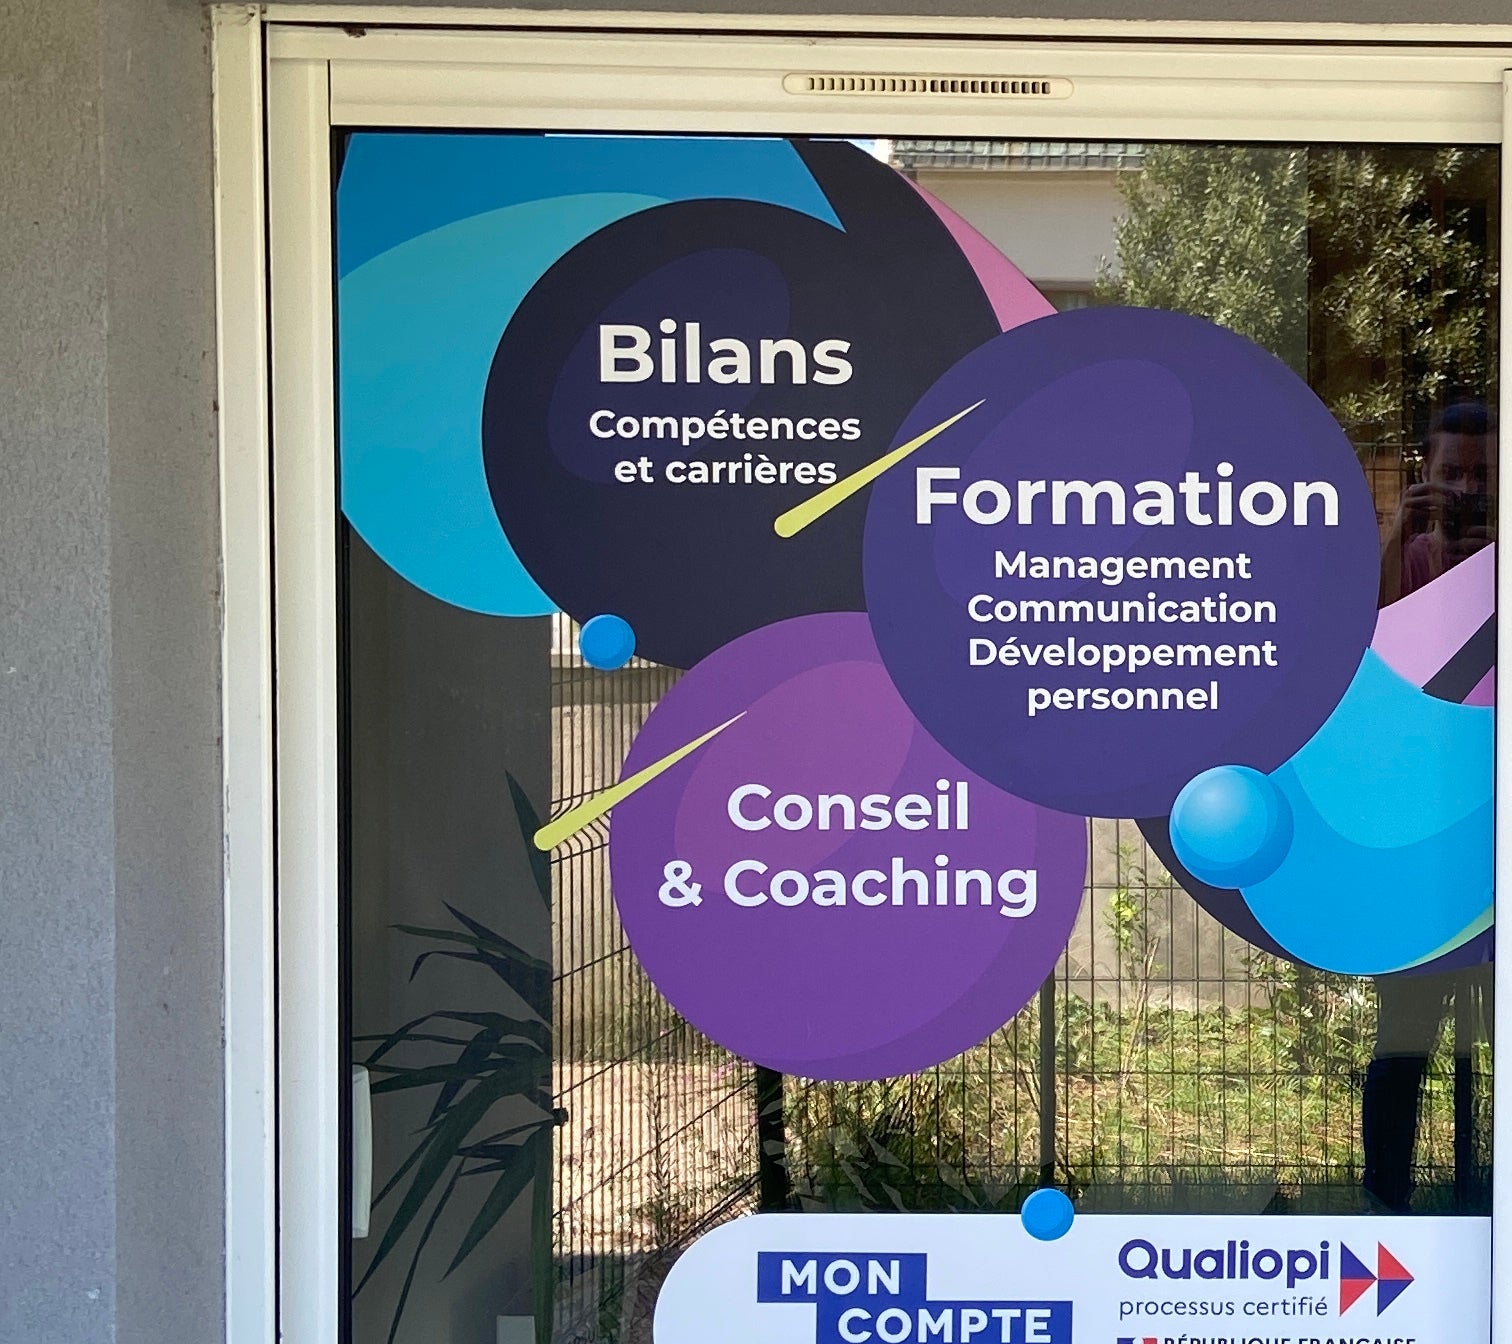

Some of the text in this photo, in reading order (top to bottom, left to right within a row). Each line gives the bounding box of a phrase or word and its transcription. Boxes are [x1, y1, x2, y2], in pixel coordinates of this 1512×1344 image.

[598, 321, 854, 386] Bilans
[588, 408, 862, 442] Compétences
[613, 452, 837, 486] et carrières
[914, 462, 1340, 527] Formation
[994, 549, 1253, 587] Management
[966, 592, 1277, 624] Communication
[968, 635, 1279, 673] Développement
[1027, 680, 1219, 718] personnel
[726, 778, 970, 832] Conseil
[657, 854, 1038, 918] & Coaching
[780, 1258, 901, 1296] MON
[1117, 1237, 1331, 1289] Qualiopi
[836, 1306, 1053, 1344] COMPTE
[1118, 1296, 1329, 1321] processus certifié
